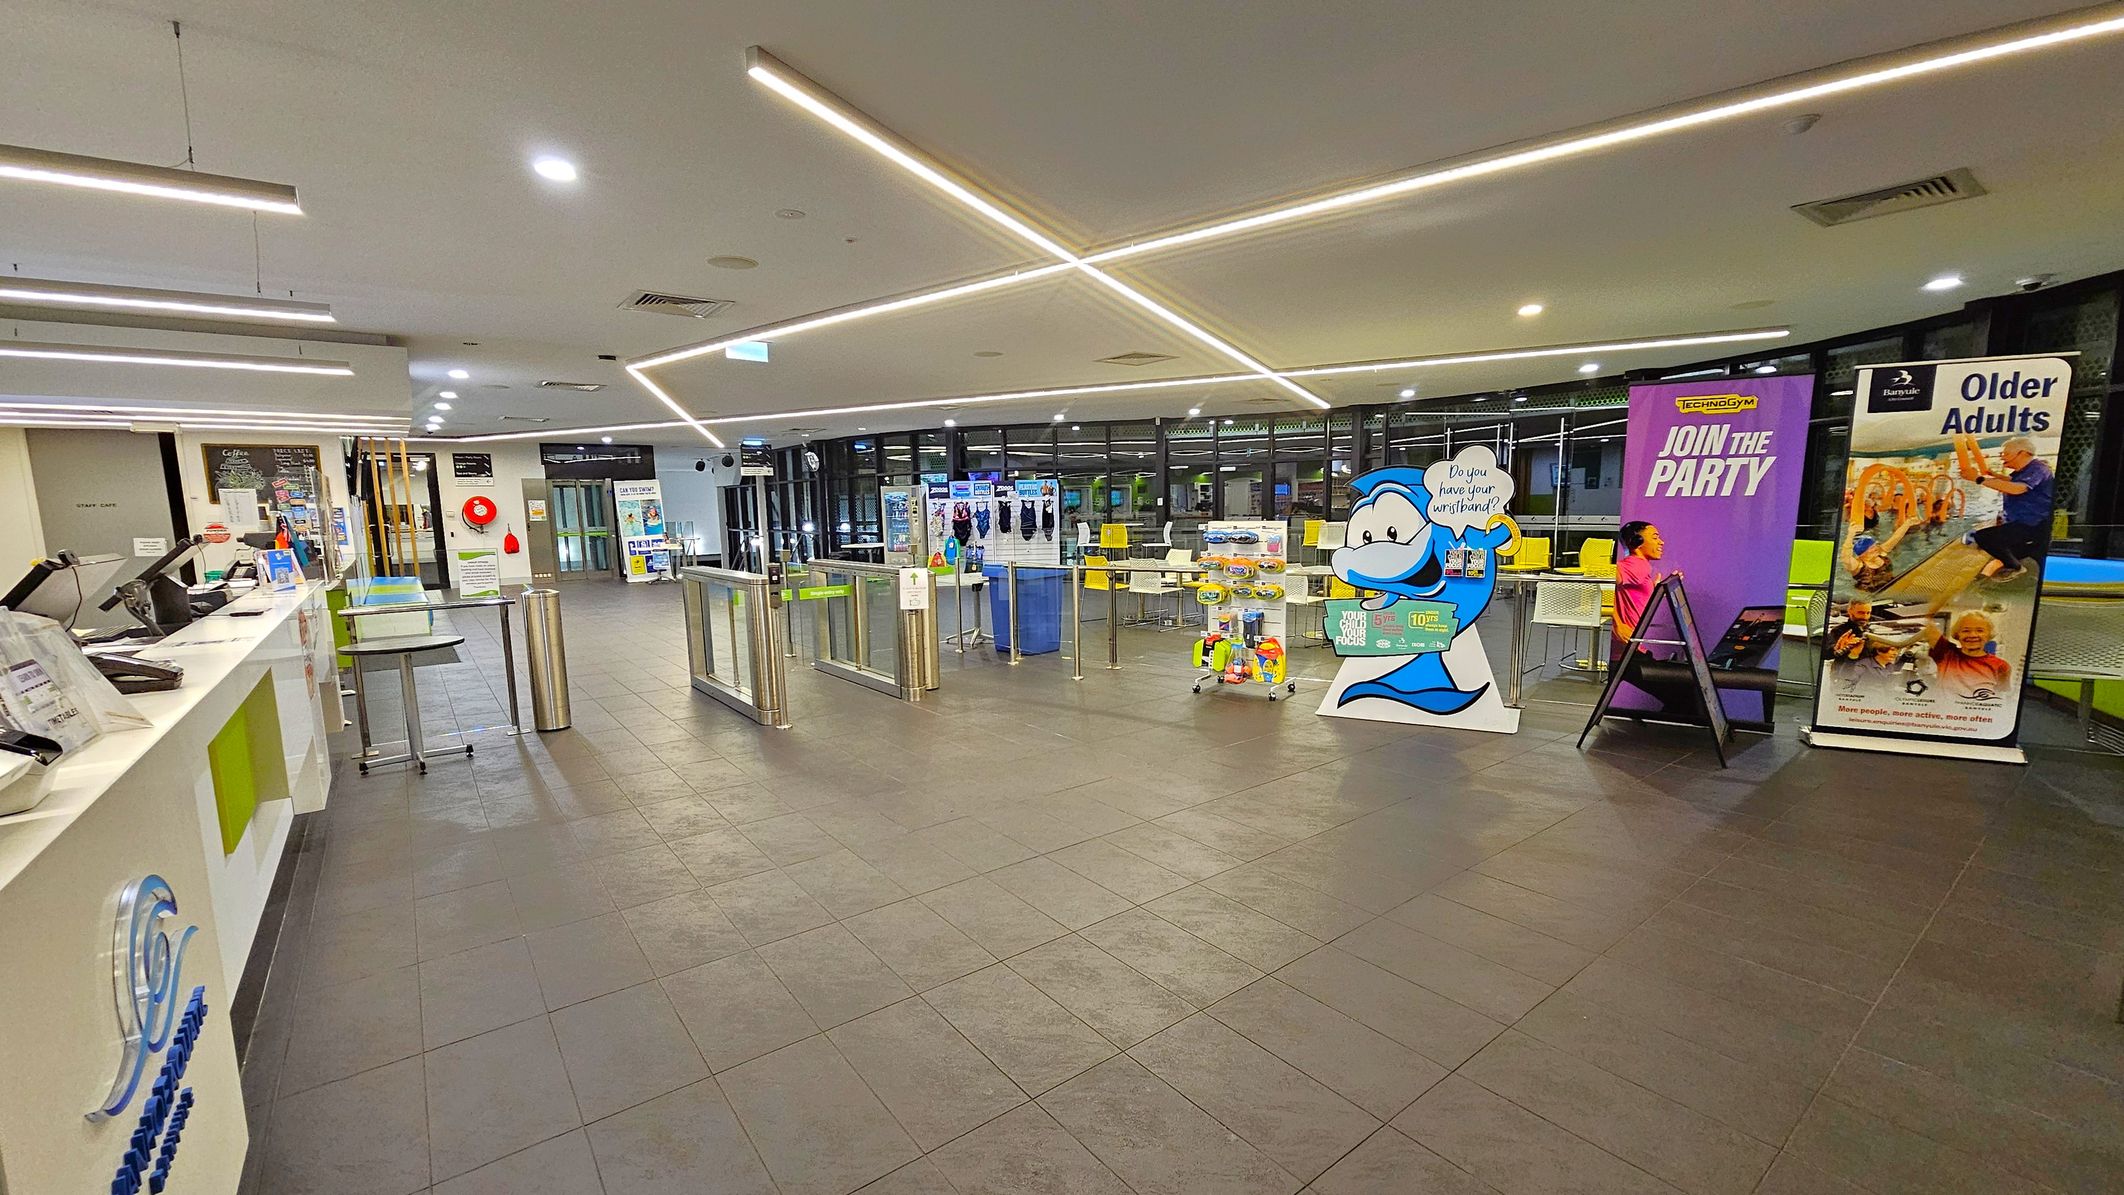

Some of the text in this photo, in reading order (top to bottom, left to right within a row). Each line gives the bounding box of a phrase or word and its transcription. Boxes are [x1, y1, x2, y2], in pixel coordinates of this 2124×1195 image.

[1883, 387, 1920, 397] Banyule
[1961, 371, 2058, 401] Older
[1941, 405, 2050, 434] Adults
[1658, 424, 1773, 457] JOIN THE
[1449, 465, 1487, 484] Do you
[1645, 457, 1777, 497] PARTY
[1440, 481, 1495, 501] have your
[1433, 496, 1500, 515] wristband?
[1339, 619, 1367, 630] CHILD
[1341, 611, 1367, 622] YOUR
[1374, 614, 1382, 626] 5
[1411, 613, 1426, 626] 10
[1335, 636, 1367, 646] FOCUS
[1341, 628, 1367, 639] YOUR
[1838, 705, 1859, 714] More
[1860, 708, 1890, 716] people,
[1892, 710, 1914, 718] more
[1915, 711, 1944, 720] active,
[1970, 715, 1993, 723] often
